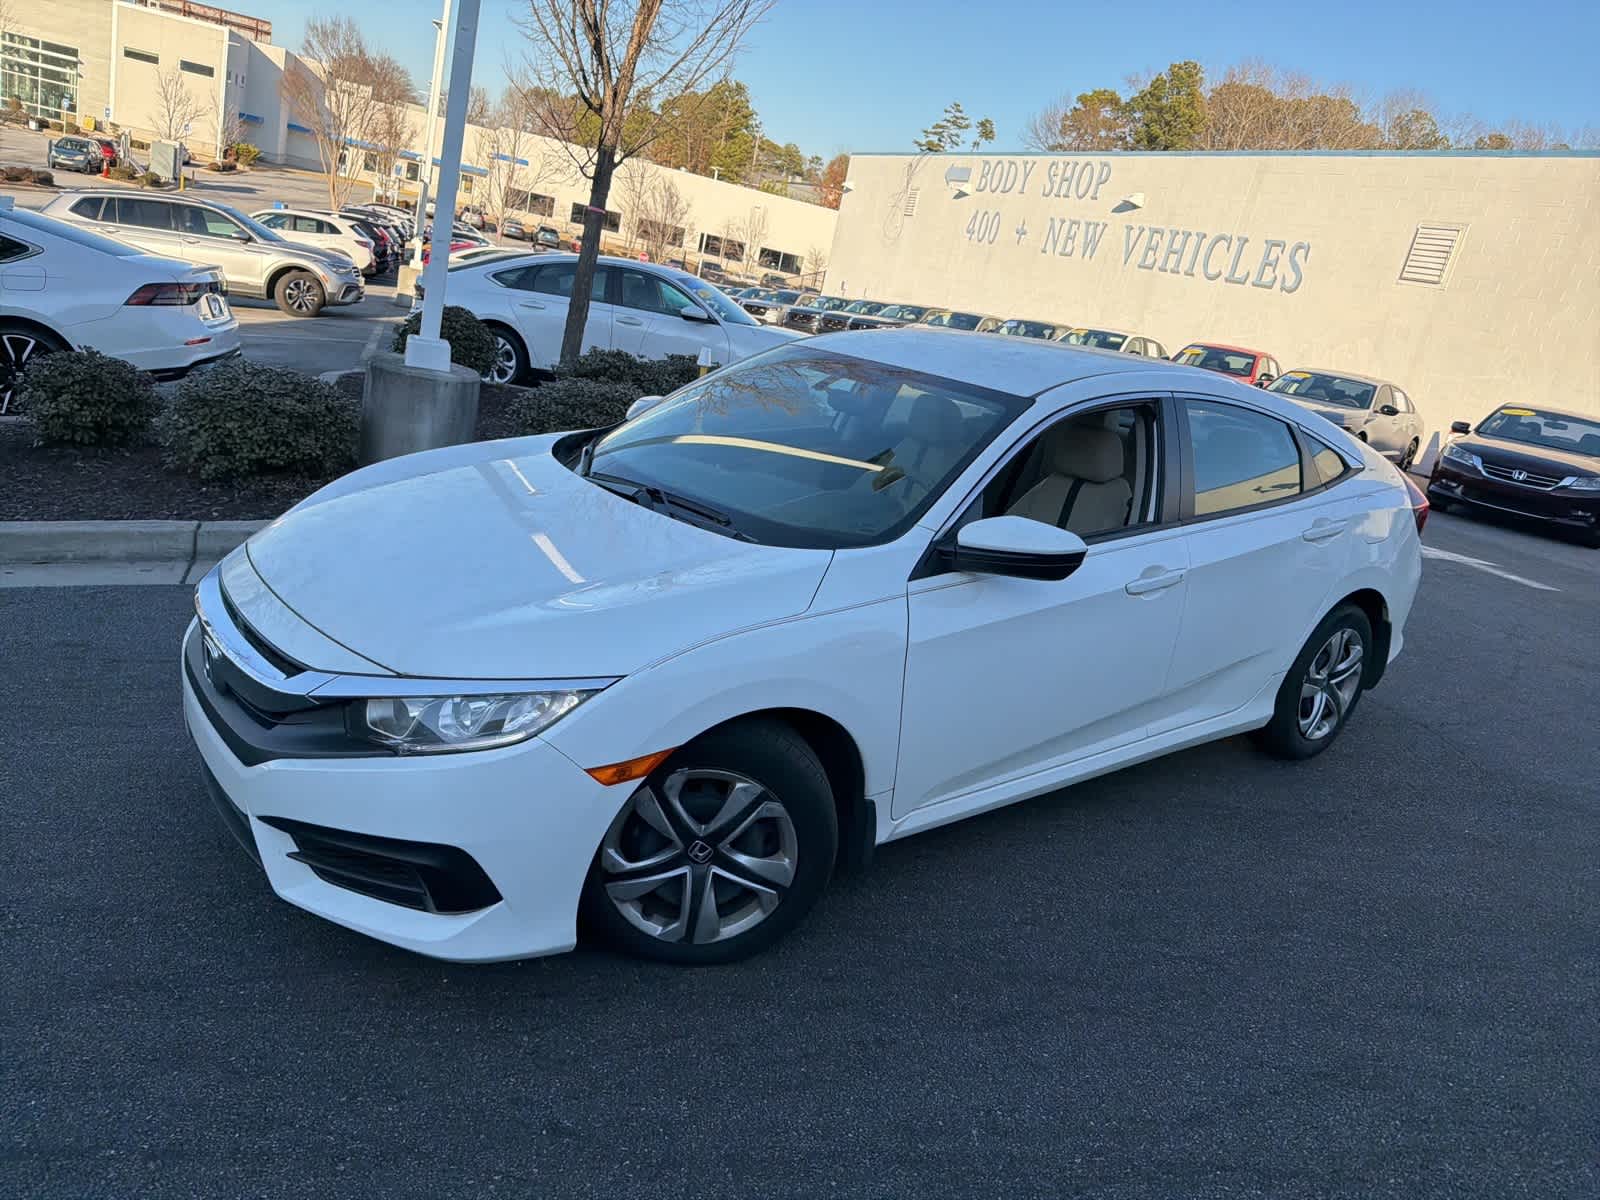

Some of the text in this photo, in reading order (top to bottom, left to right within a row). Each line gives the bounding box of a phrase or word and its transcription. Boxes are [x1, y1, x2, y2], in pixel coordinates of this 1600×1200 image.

[975, 160, 1112, 200] BODY SHOP
[965, 210, 1001, 245] 400
[1040, 217, 1108, 260] NEW
[1123, 224, 1311, 295] VEHICLES
